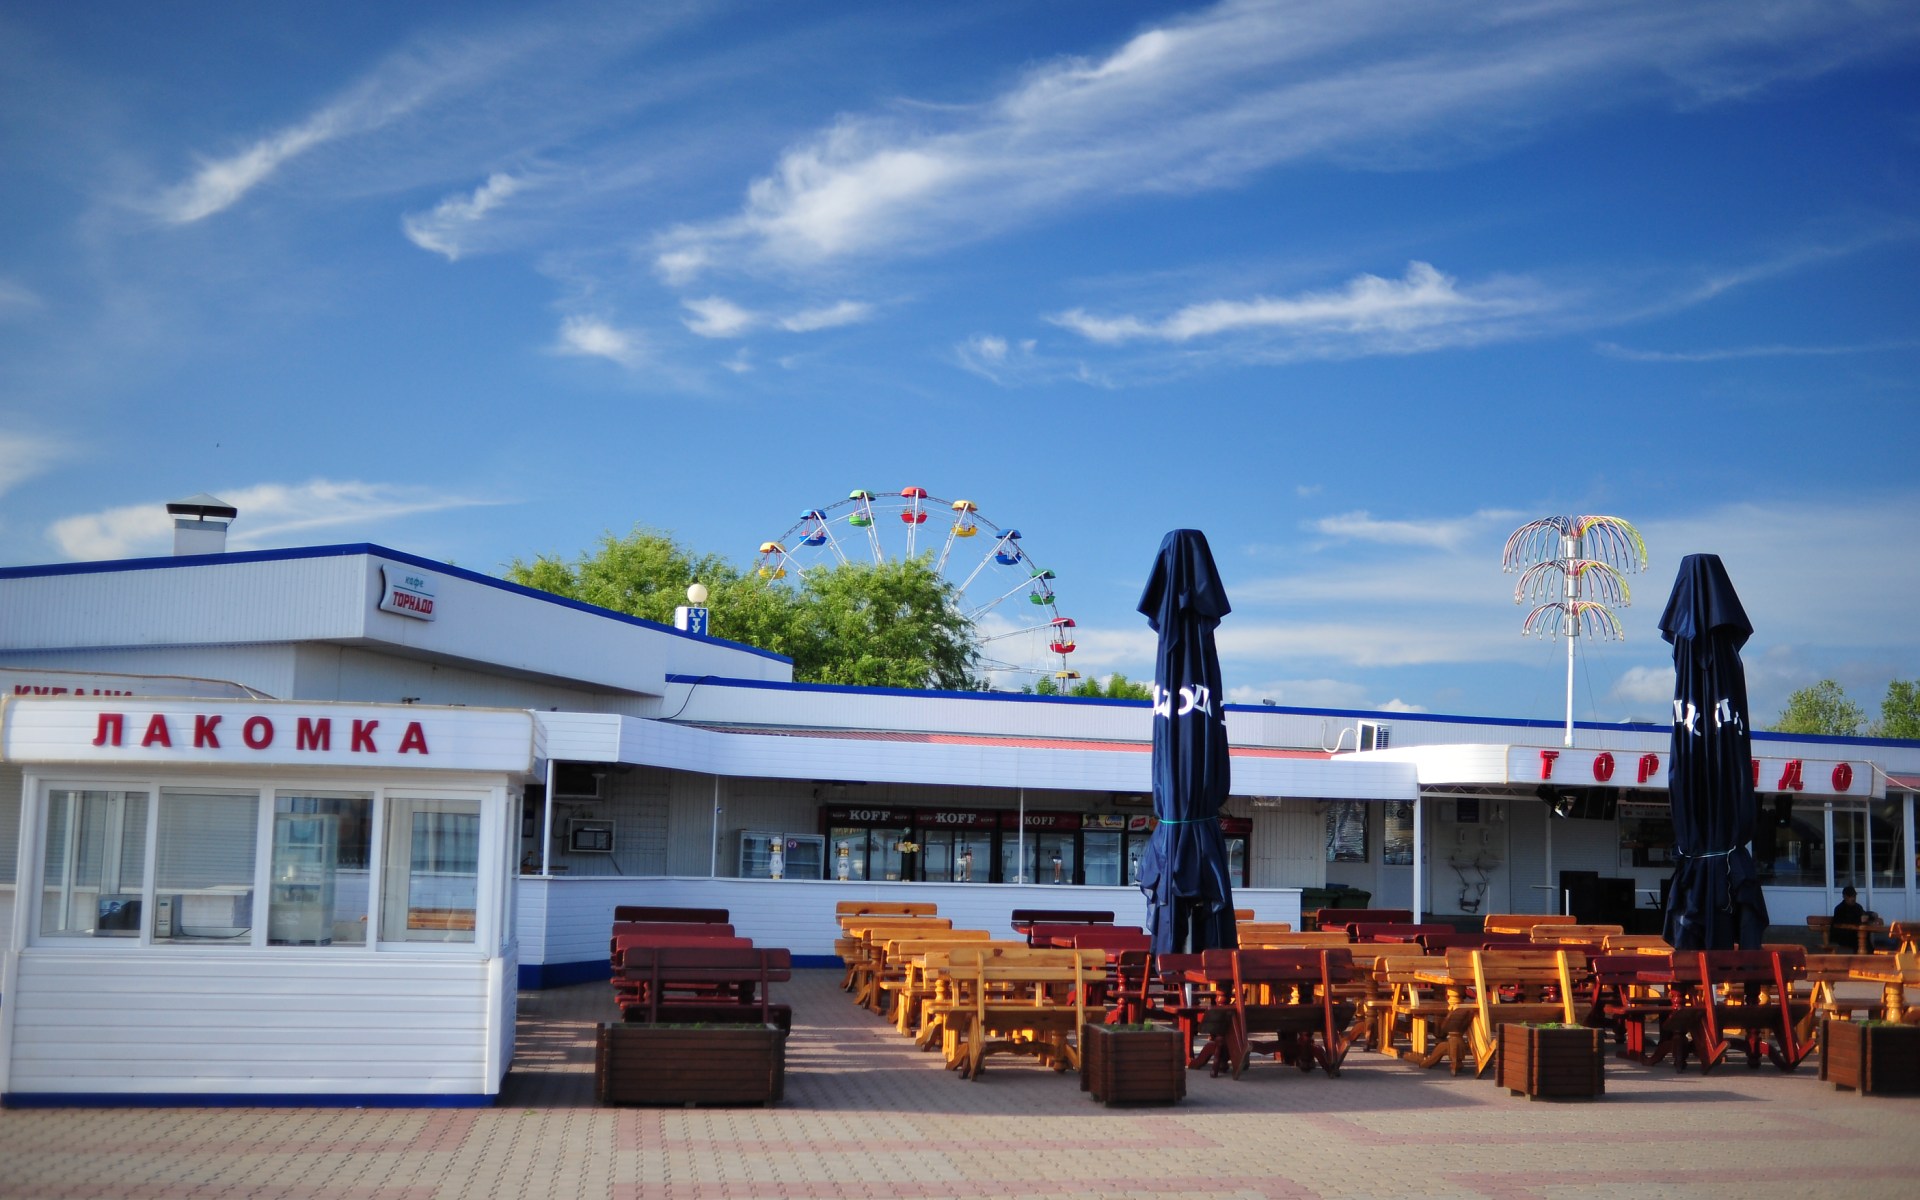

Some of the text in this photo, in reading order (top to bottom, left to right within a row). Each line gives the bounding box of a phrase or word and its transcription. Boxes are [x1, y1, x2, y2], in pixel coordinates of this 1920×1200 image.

[405, 576, 424, 589] кафе
[392, 591, 433, 614] ТОРНАДО
[92, 713, 428, 755] ЛАКОМКА
[1540, 750, 1853, 792] ТОРДО
[849, 809, 890, 821] KOFF
[936, 812, 977, 824] KOFF
[1025, 816, 1056, 825] KOFF
